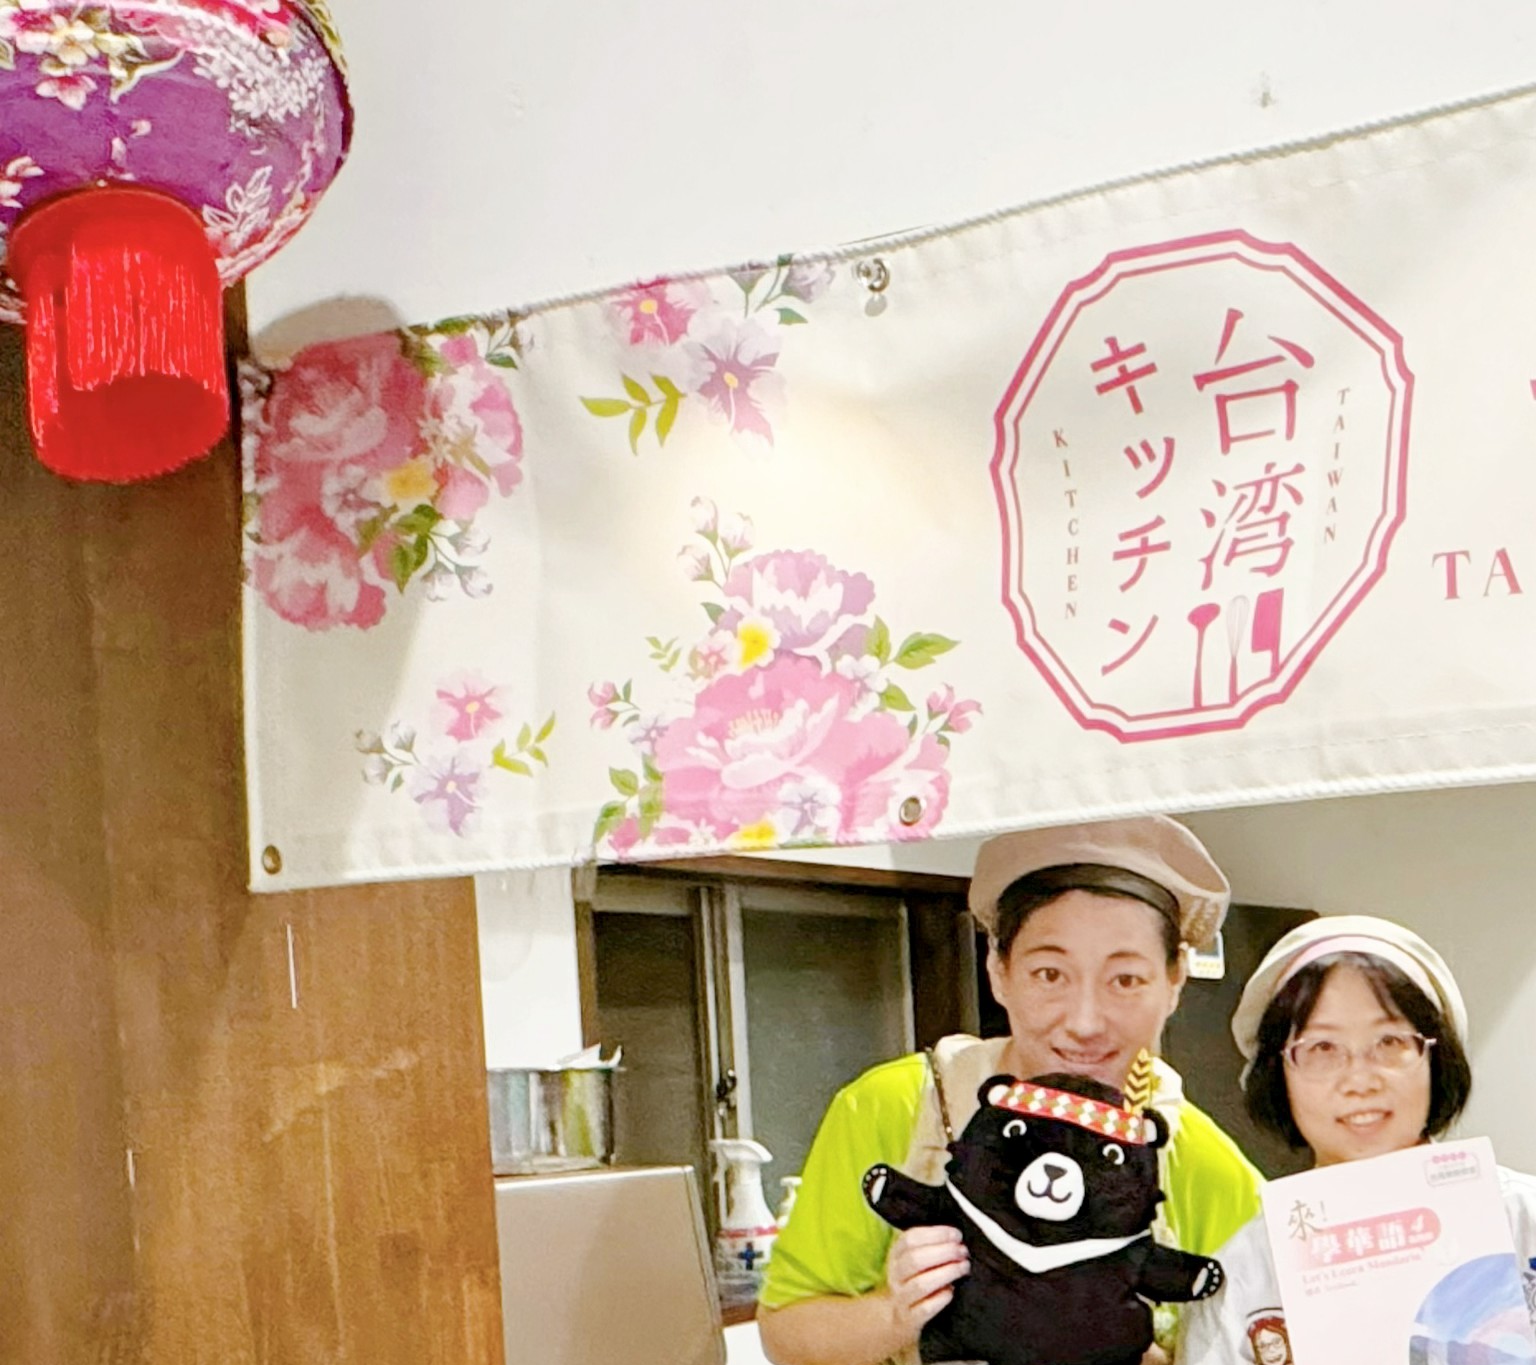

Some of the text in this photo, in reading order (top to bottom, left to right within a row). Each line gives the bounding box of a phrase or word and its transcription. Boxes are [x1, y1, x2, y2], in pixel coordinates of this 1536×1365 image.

[1051, 426, 1080, 620] KITCHEN
[1089, 335, 1176, 677] キッチン
[1193, 308, 1316, 591] 台湾
[1323, 387, 1351, 546] TAIWAN
